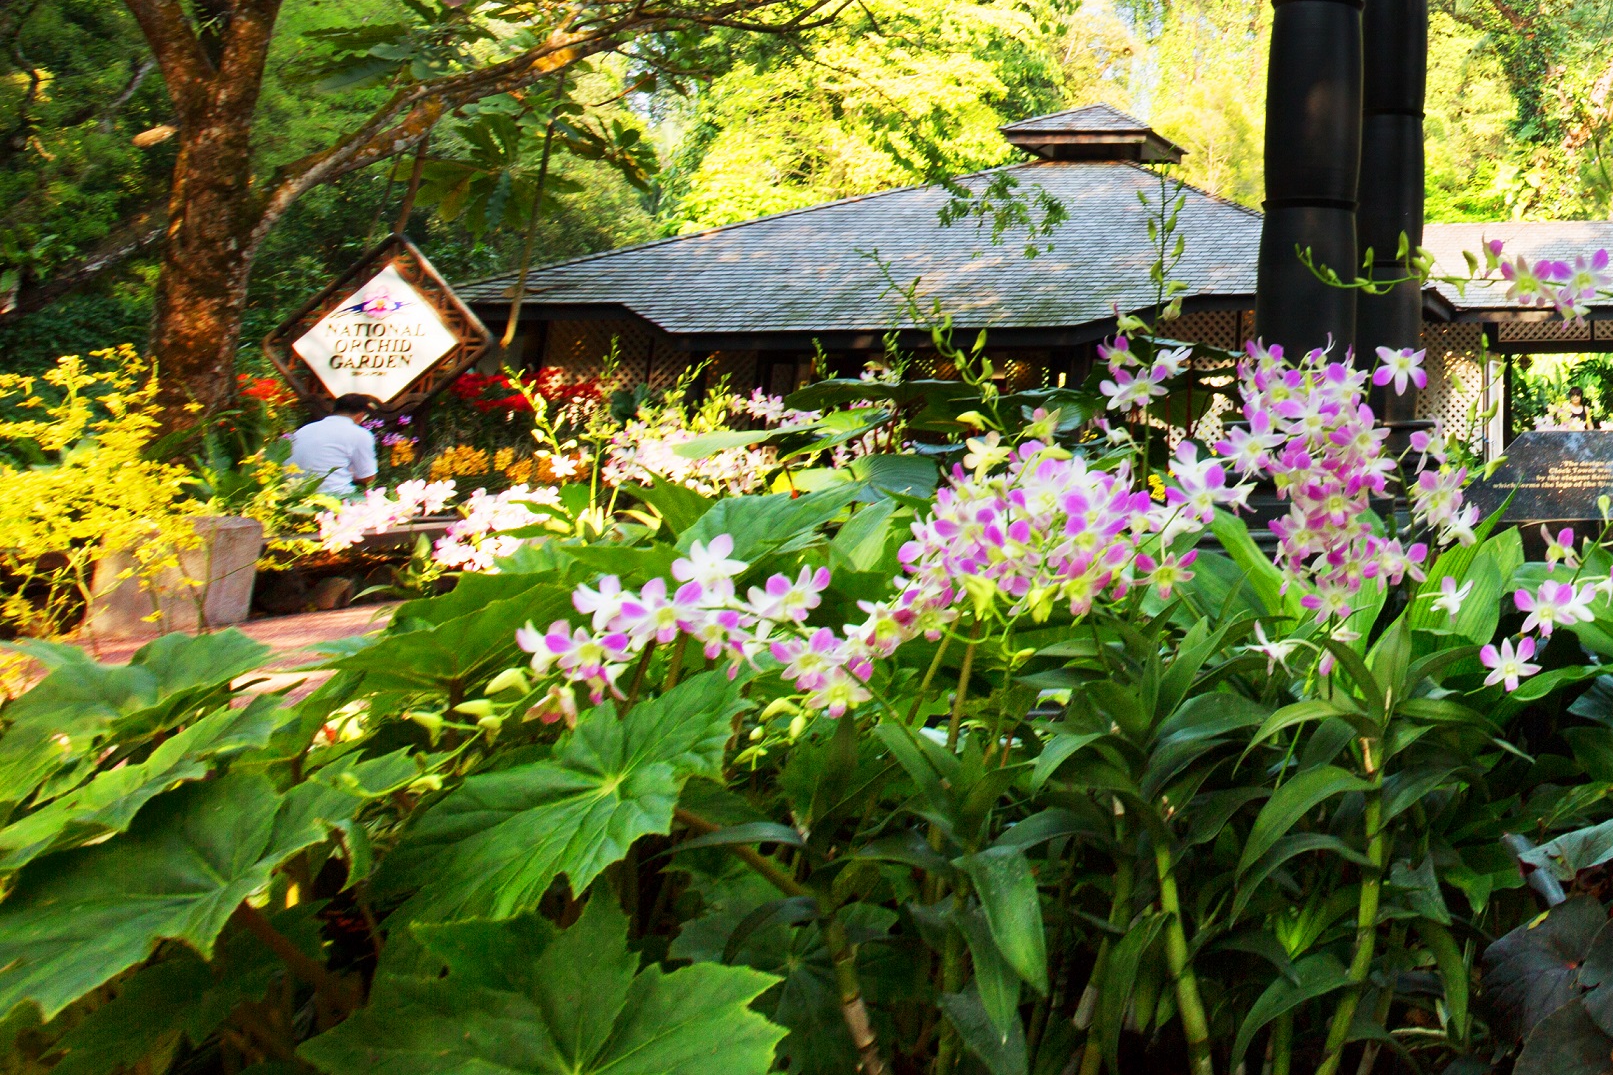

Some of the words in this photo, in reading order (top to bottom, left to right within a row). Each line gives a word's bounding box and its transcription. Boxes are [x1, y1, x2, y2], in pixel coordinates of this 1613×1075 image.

[325, 322, 426, 337] NATIONAL
[335, 338, 412, 353] ORCHID
[328, 354, 413, 370] GARDEN
[1541, 481, 1554, 489] the
